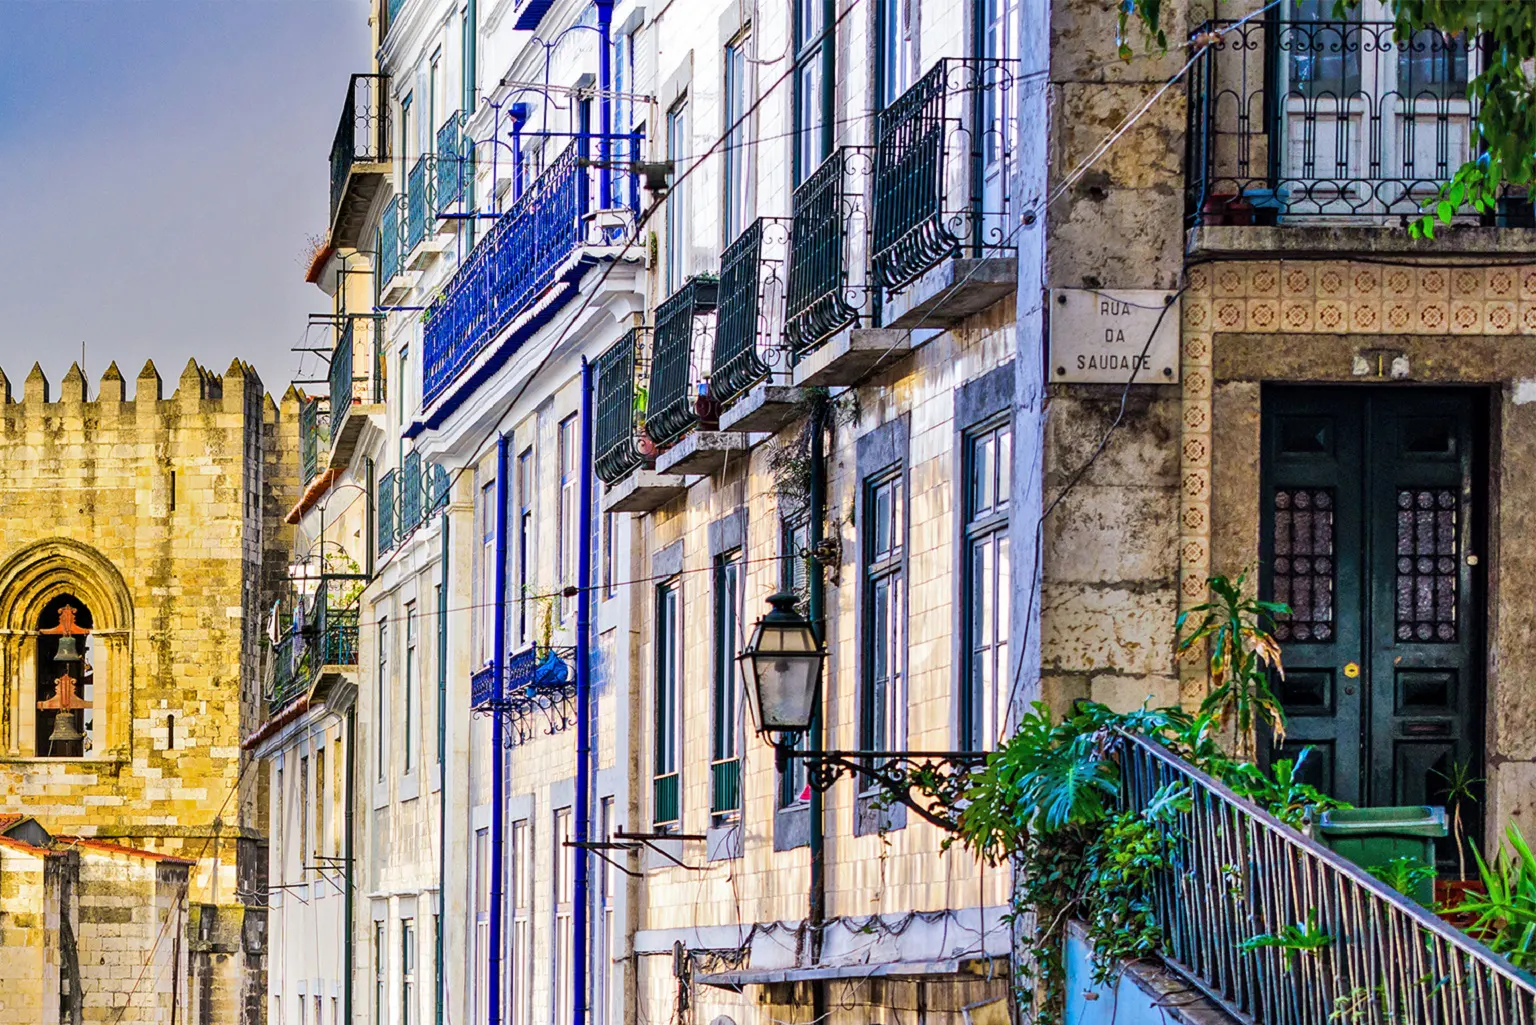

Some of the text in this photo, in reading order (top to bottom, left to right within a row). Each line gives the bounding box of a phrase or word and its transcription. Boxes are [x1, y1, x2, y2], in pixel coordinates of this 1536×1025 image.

[1101, 302, 1130, 315] RUA
[1105, 329, 1125, 343] DA
[1077, 355, 1151, 370] SAUDADE
